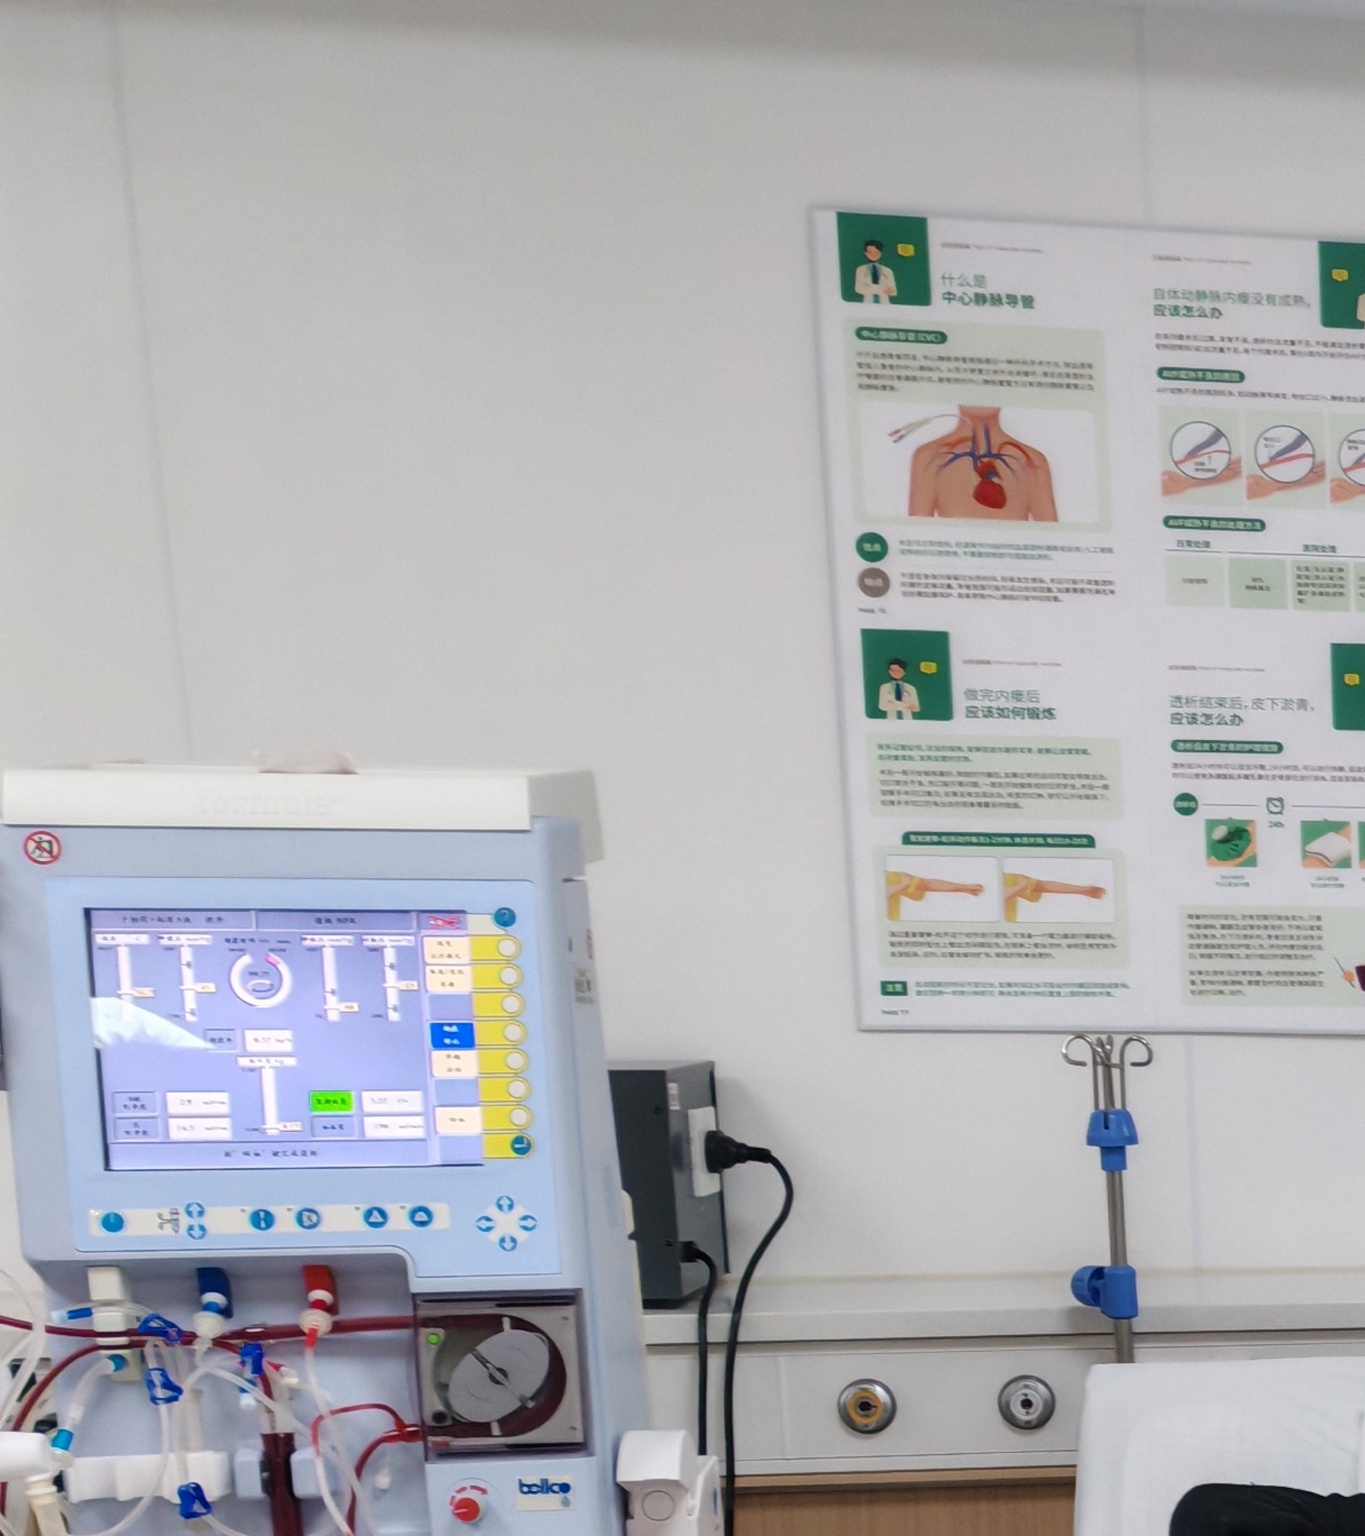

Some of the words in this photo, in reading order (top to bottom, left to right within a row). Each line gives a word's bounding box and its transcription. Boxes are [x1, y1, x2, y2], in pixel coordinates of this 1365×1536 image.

[941, 272, 987, 289] 什么是
[941, 291, 1035, 310] 中心静脉导管
[1153, 304, 1223, 319] 应该怎么办
[964, 705, 1057, 721] 应该如何锻炼
[1169, 712, 1244, 727] 应该怎么办
